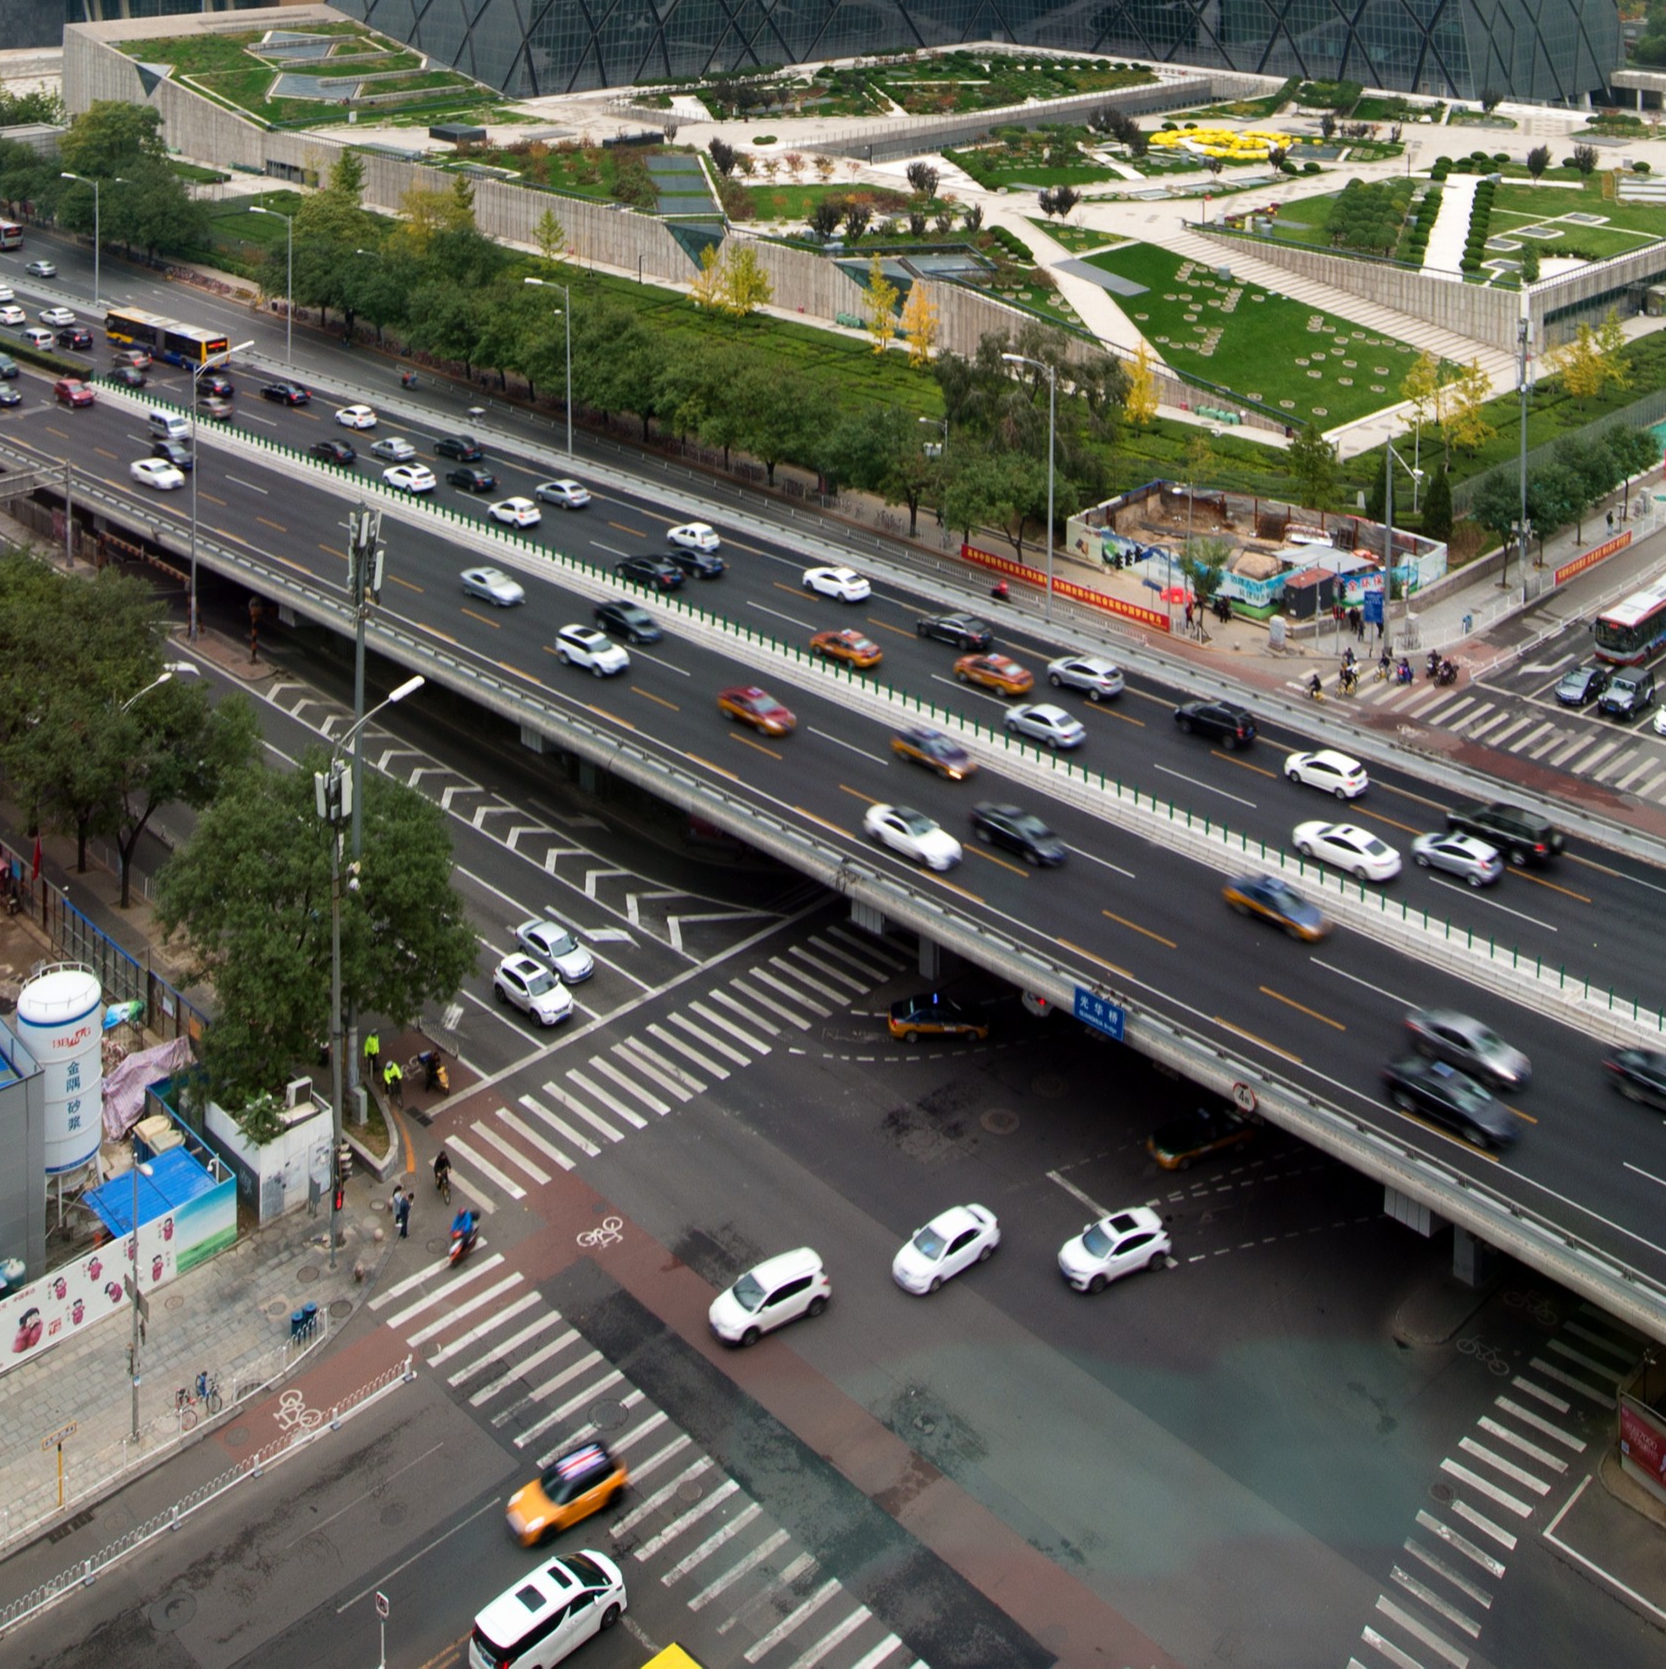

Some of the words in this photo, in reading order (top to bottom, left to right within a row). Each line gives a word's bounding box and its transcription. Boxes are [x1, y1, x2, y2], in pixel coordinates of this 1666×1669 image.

[1080, 996, 1118, 1024] 光华桥
[66, 1061, 81, 1092] 金隅
[67, 1099, 81, 1131] 砂浆
